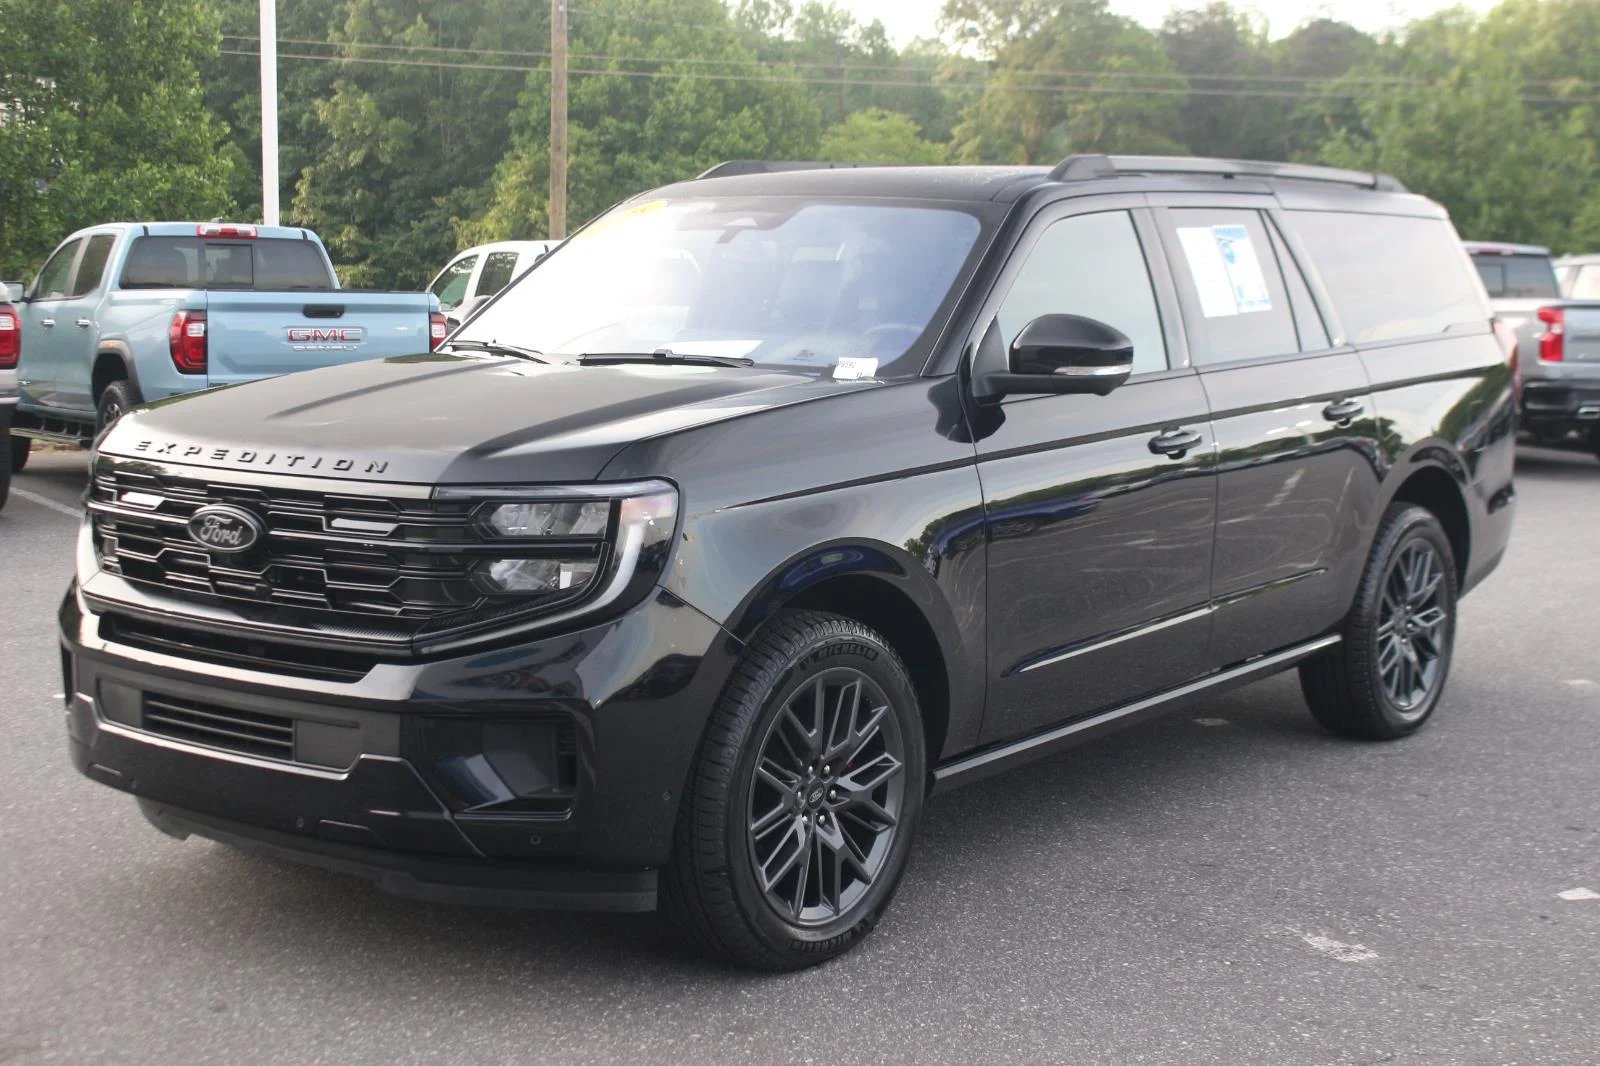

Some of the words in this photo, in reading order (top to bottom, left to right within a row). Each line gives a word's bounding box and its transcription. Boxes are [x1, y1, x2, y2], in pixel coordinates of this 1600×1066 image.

[287, 327, 362, 343] GMC
[135, 440, 389, 474] EXPEDITION
[201, 514, 243, 546] Ford
[818, 643, 878, 661] MICHELIN
